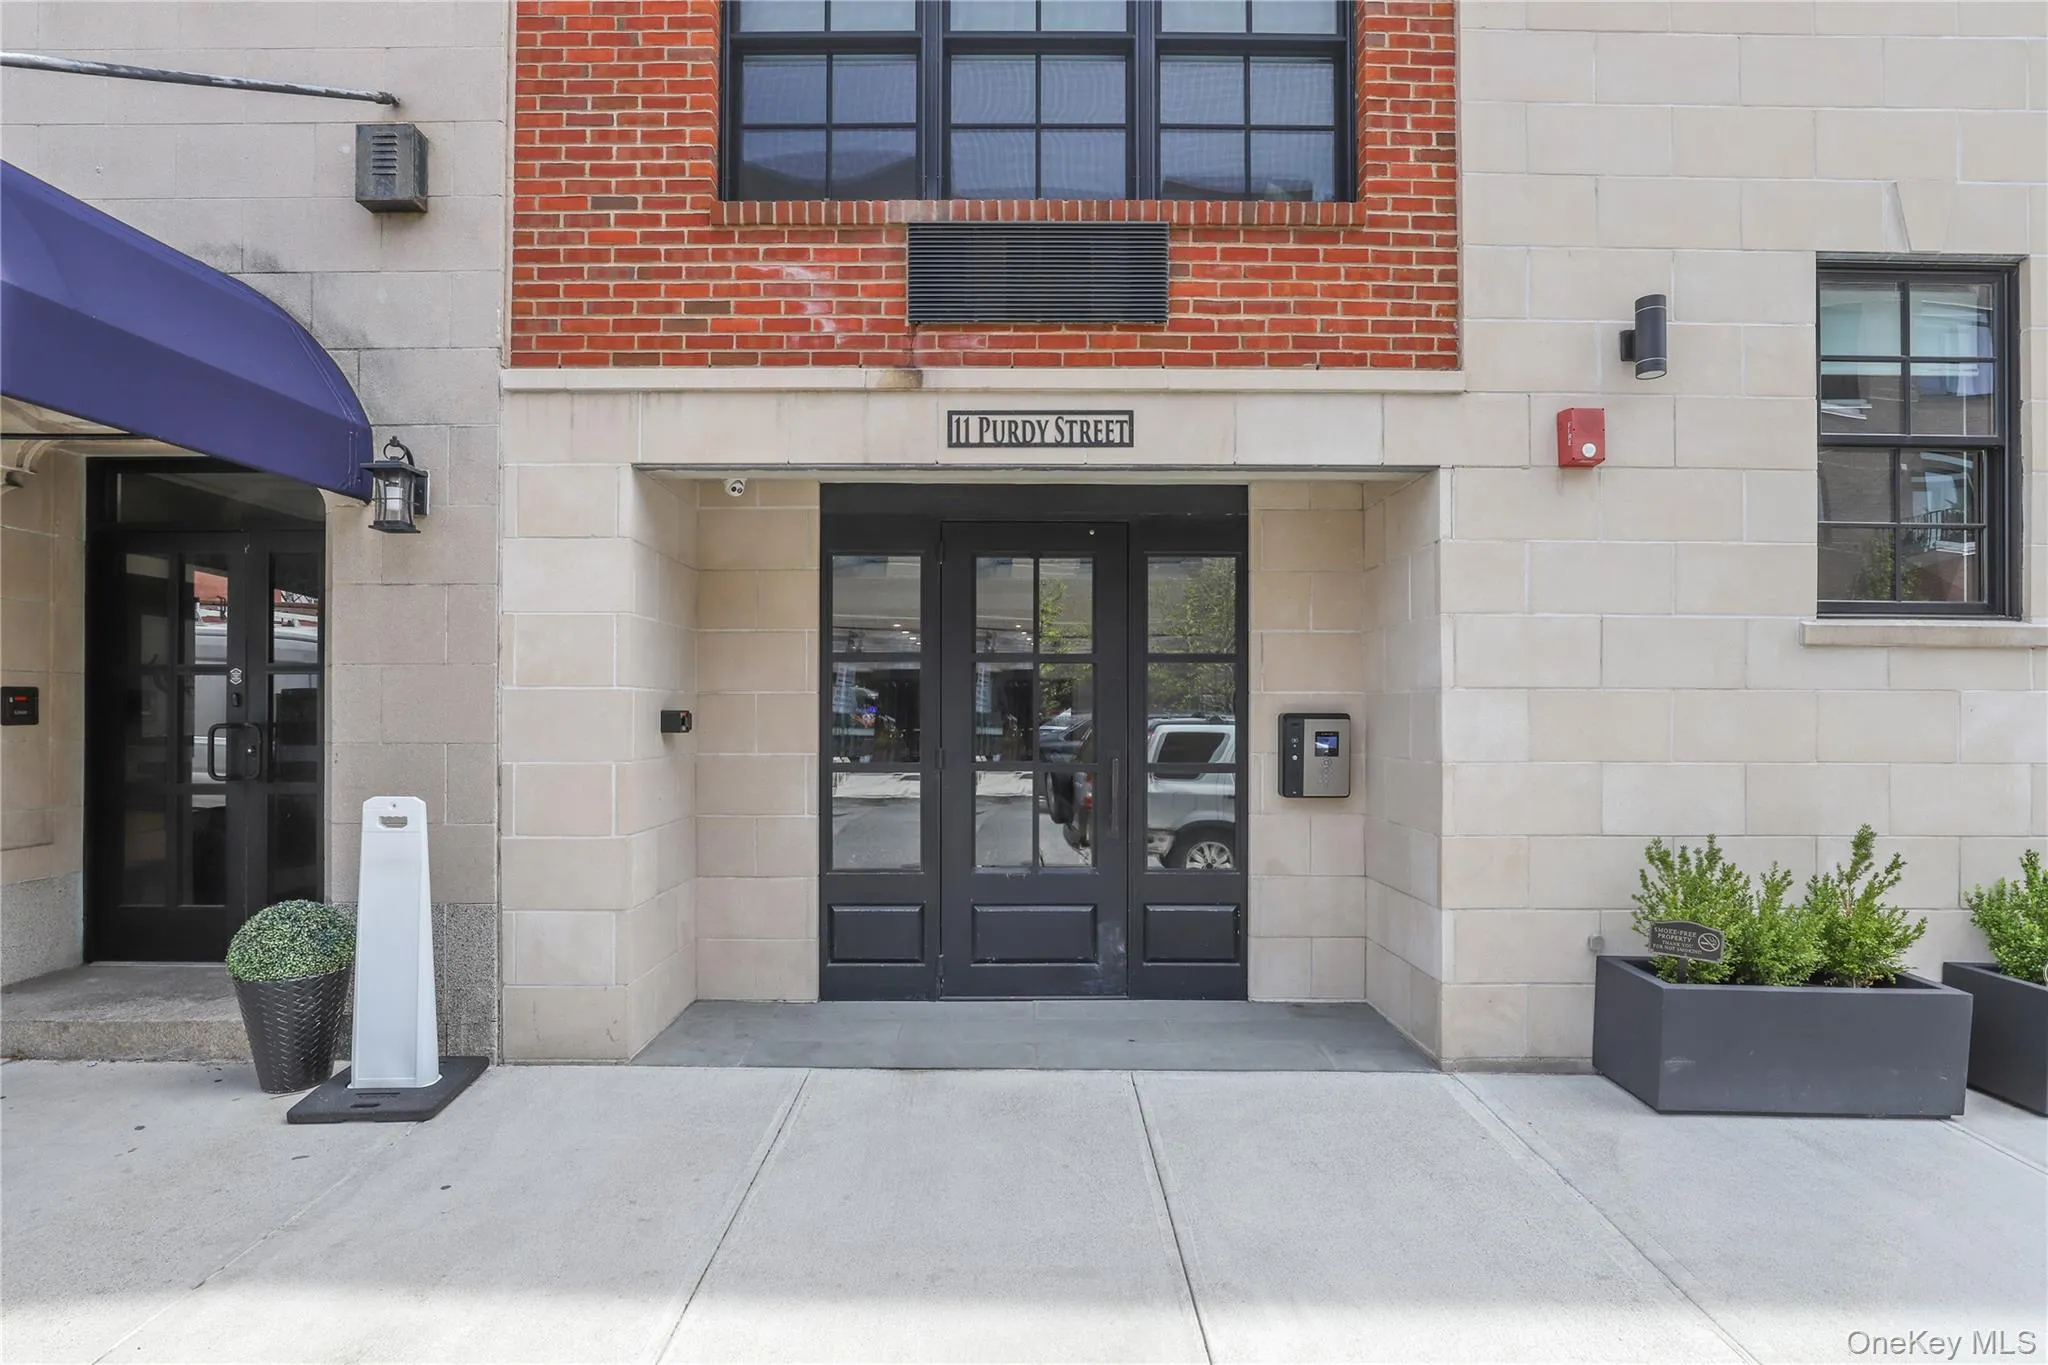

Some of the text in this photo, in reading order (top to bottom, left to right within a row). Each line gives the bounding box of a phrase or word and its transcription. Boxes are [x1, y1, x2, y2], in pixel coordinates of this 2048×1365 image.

[954, 416, 1129, 444] 11 PURDY STREET
[1654, 927, 1697, 938] SMOKE-FREE
[1657, 934, 1692, 942] PROPERTY
